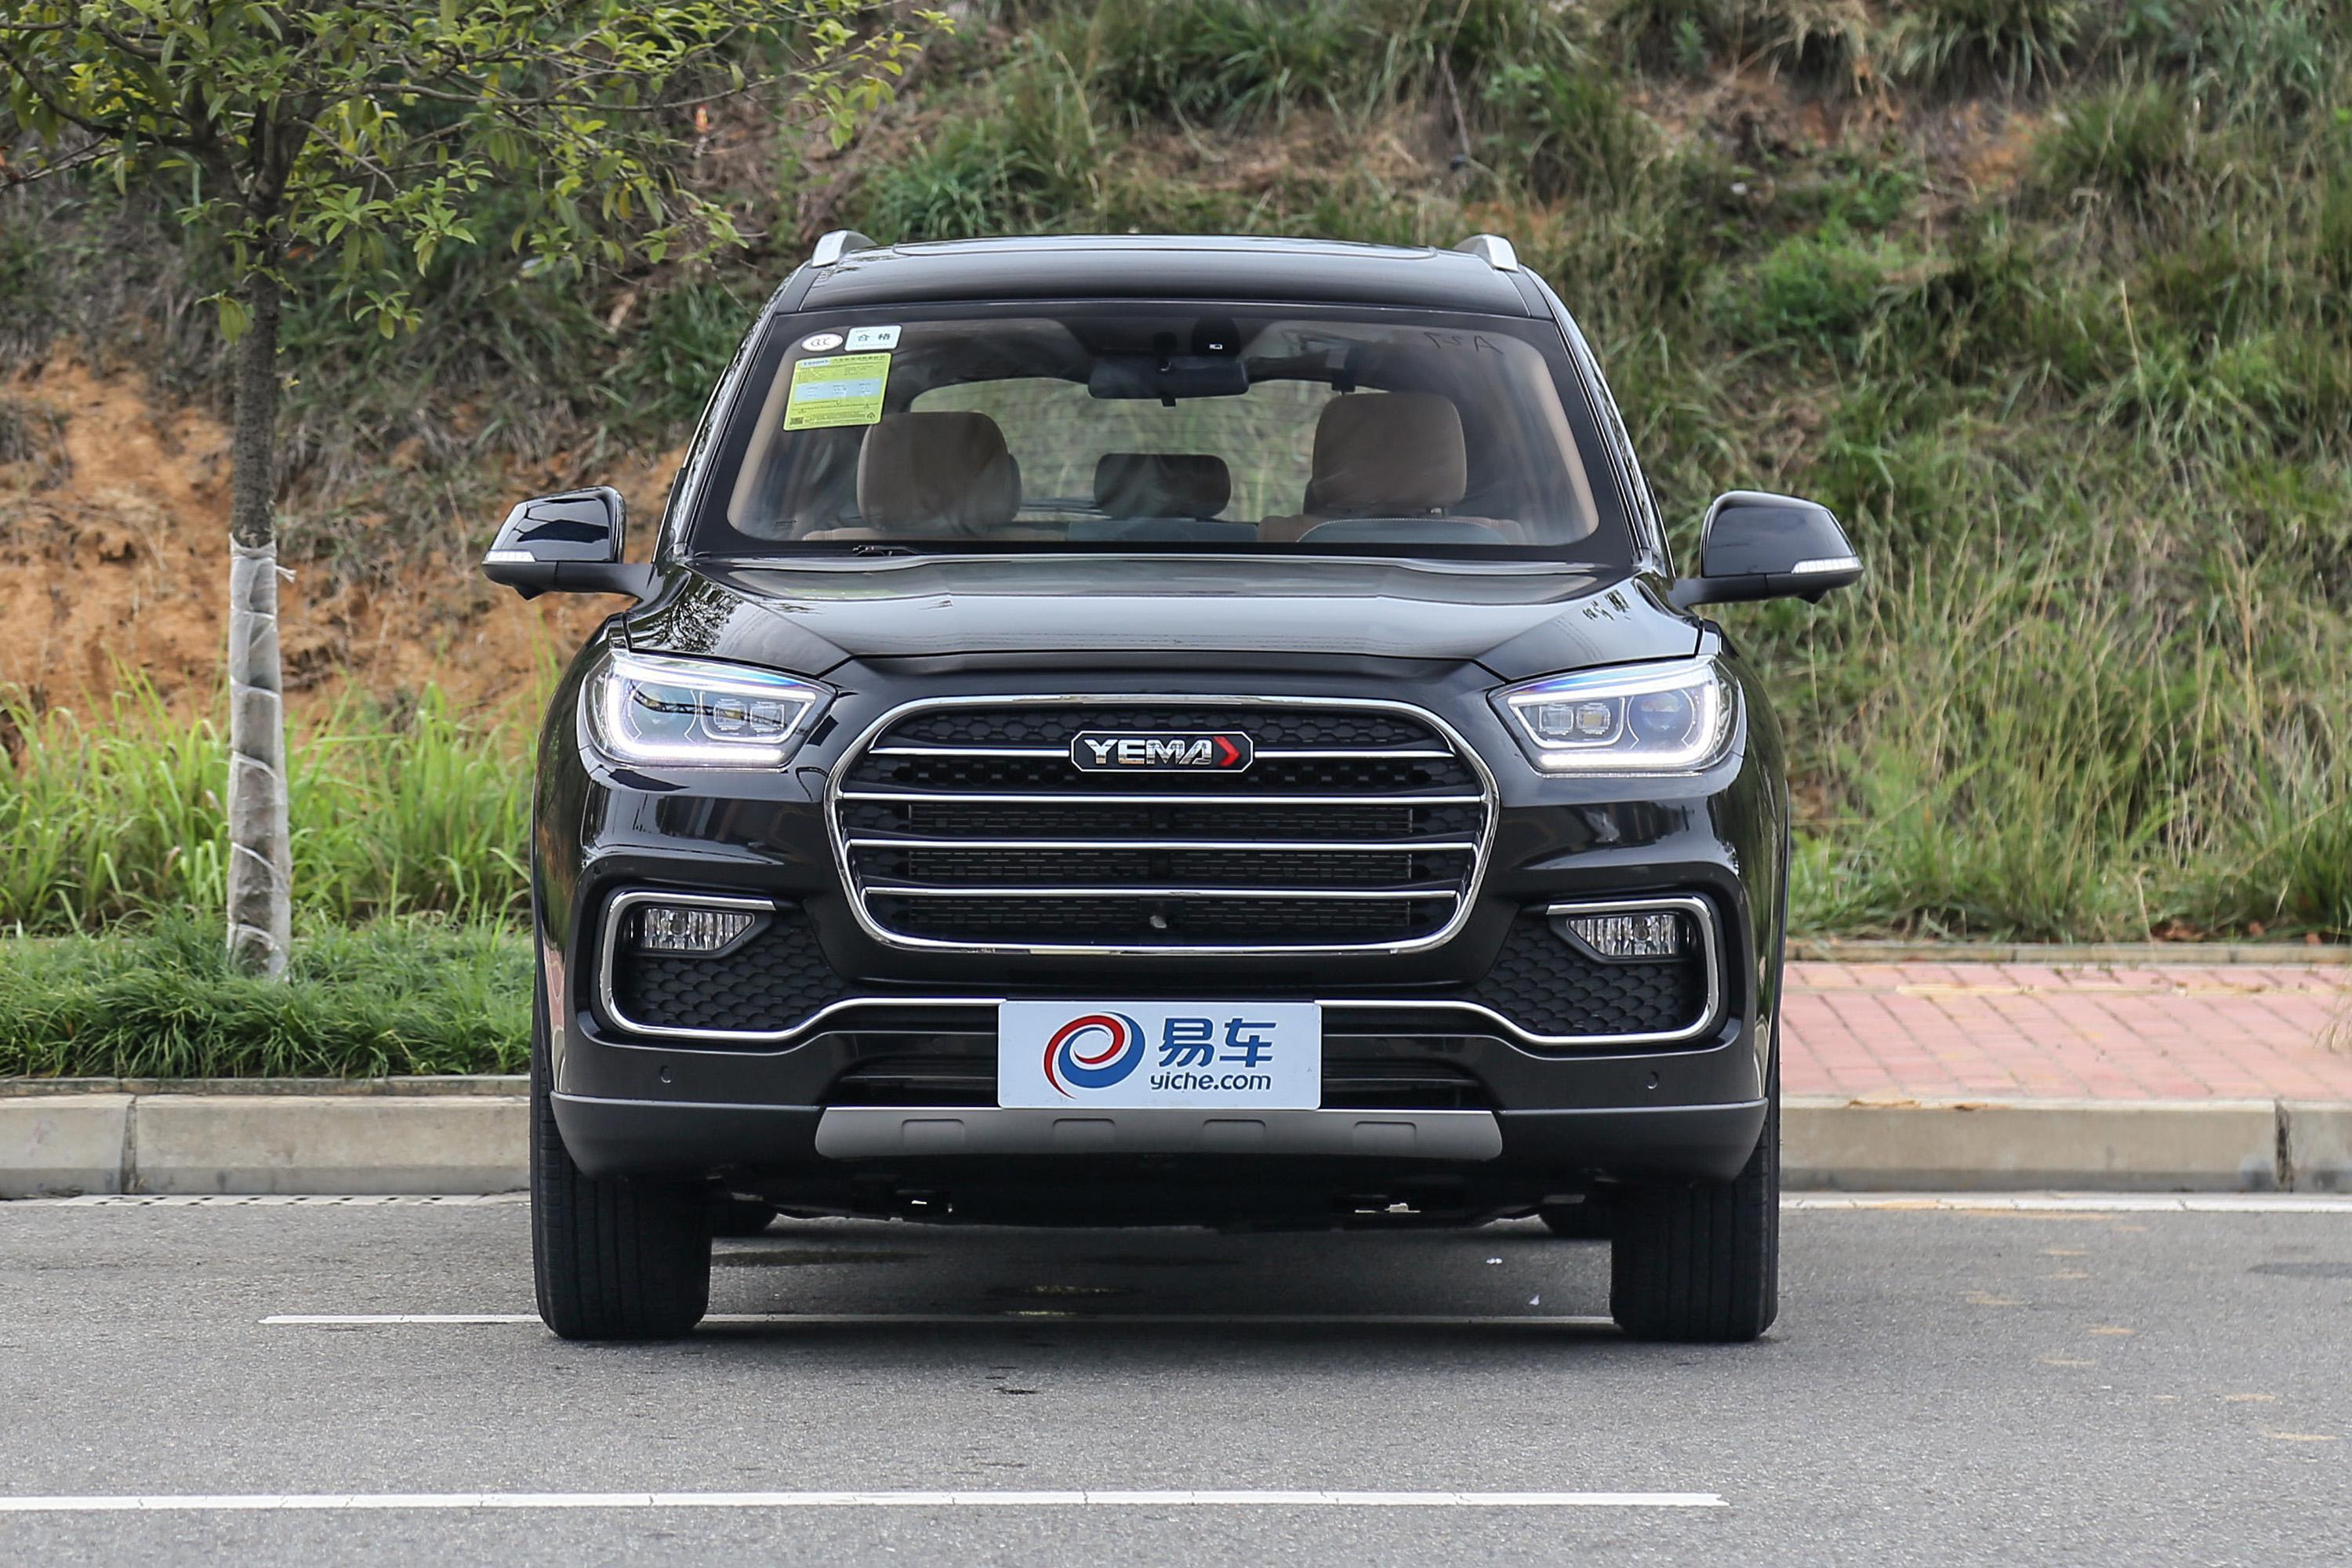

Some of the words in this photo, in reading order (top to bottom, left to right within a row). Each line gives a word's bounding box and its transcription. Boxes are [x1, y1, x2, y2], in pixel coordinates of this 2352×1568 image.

[1083, 739, 1213, 765] YEMA
[1158, 1018, 1277, 1068] 易车
[1150, 1072, 1272, 1091] yiche.com
